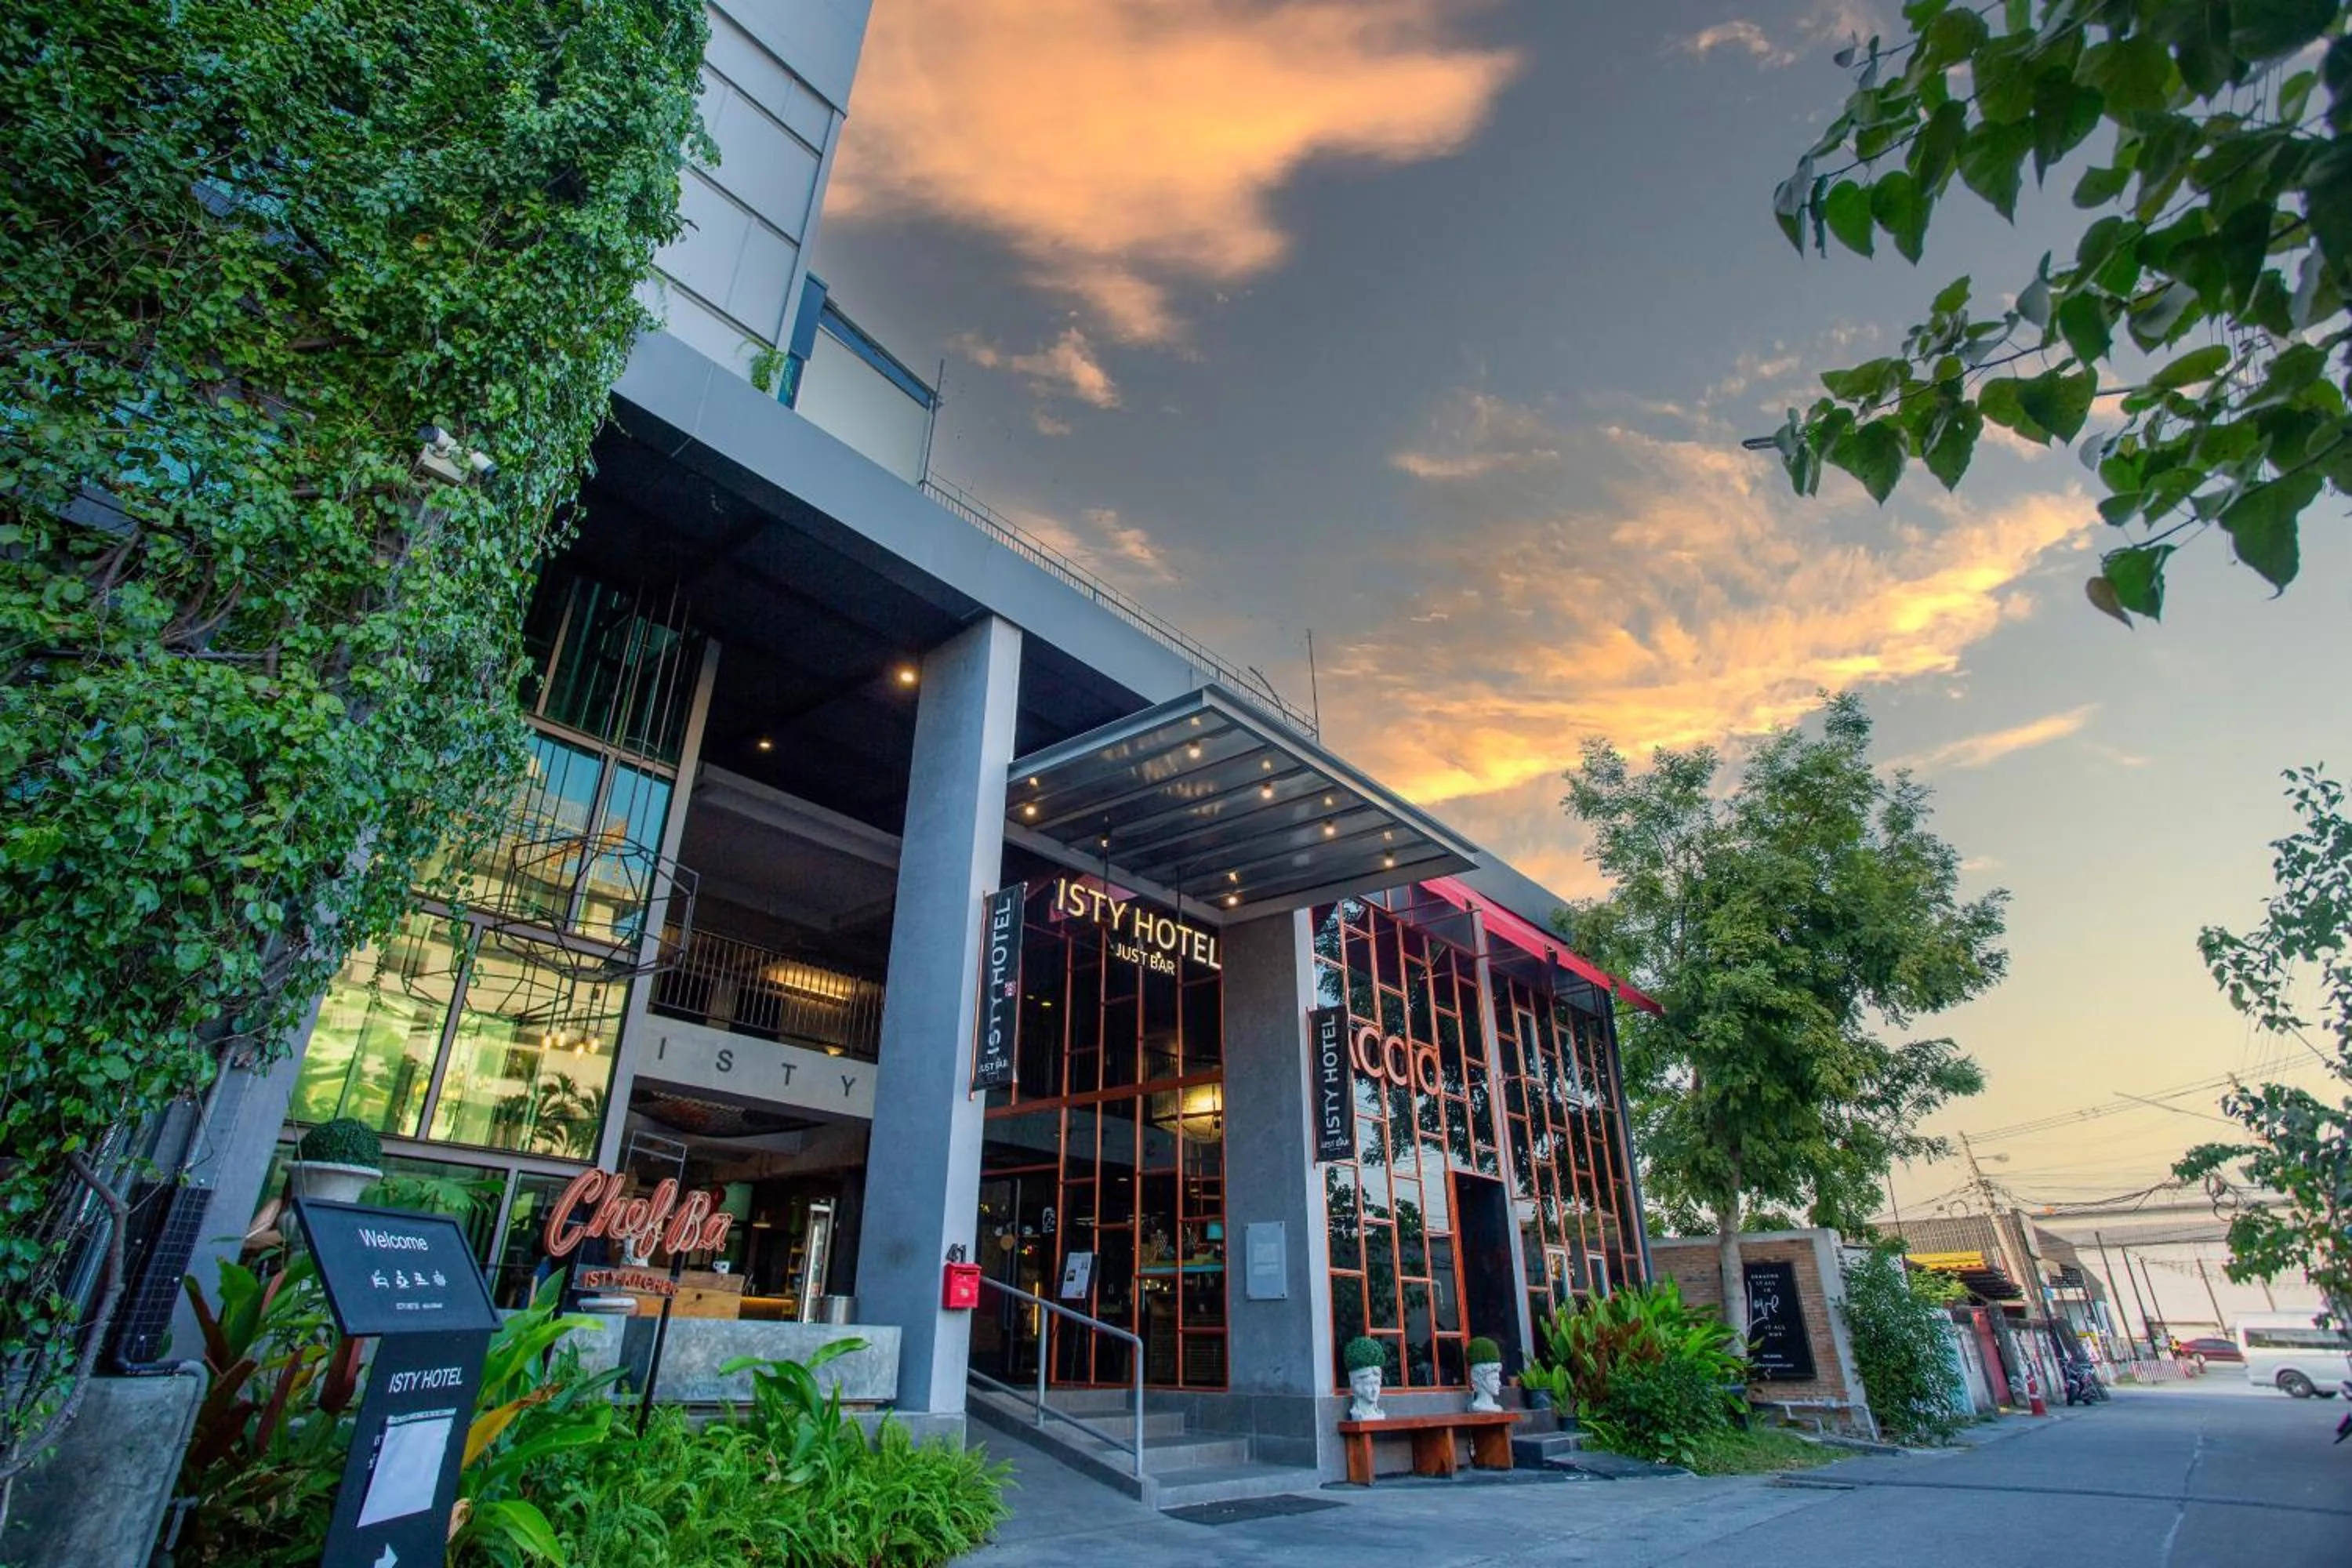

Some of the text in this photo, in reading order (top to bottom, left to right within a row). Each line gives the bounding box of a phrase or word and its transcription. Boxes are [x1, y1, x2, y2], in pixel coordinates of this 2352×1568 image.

[990, 898, 1012, 985] HOTEL
[1057, 877, 1222, 971] ISTY HOTEL
[1116, 942, 1149, 966] JUST
[986, 996, 1004, 1055] ISTY
[1322, 1014, 1341, 1136] ISTY HOTEL
[358, 1229, 429, 1250] Welcome
[544, 1167, 679, 1258] Chef
[388, 1367, 463, 1393] ISTY HOTEL
